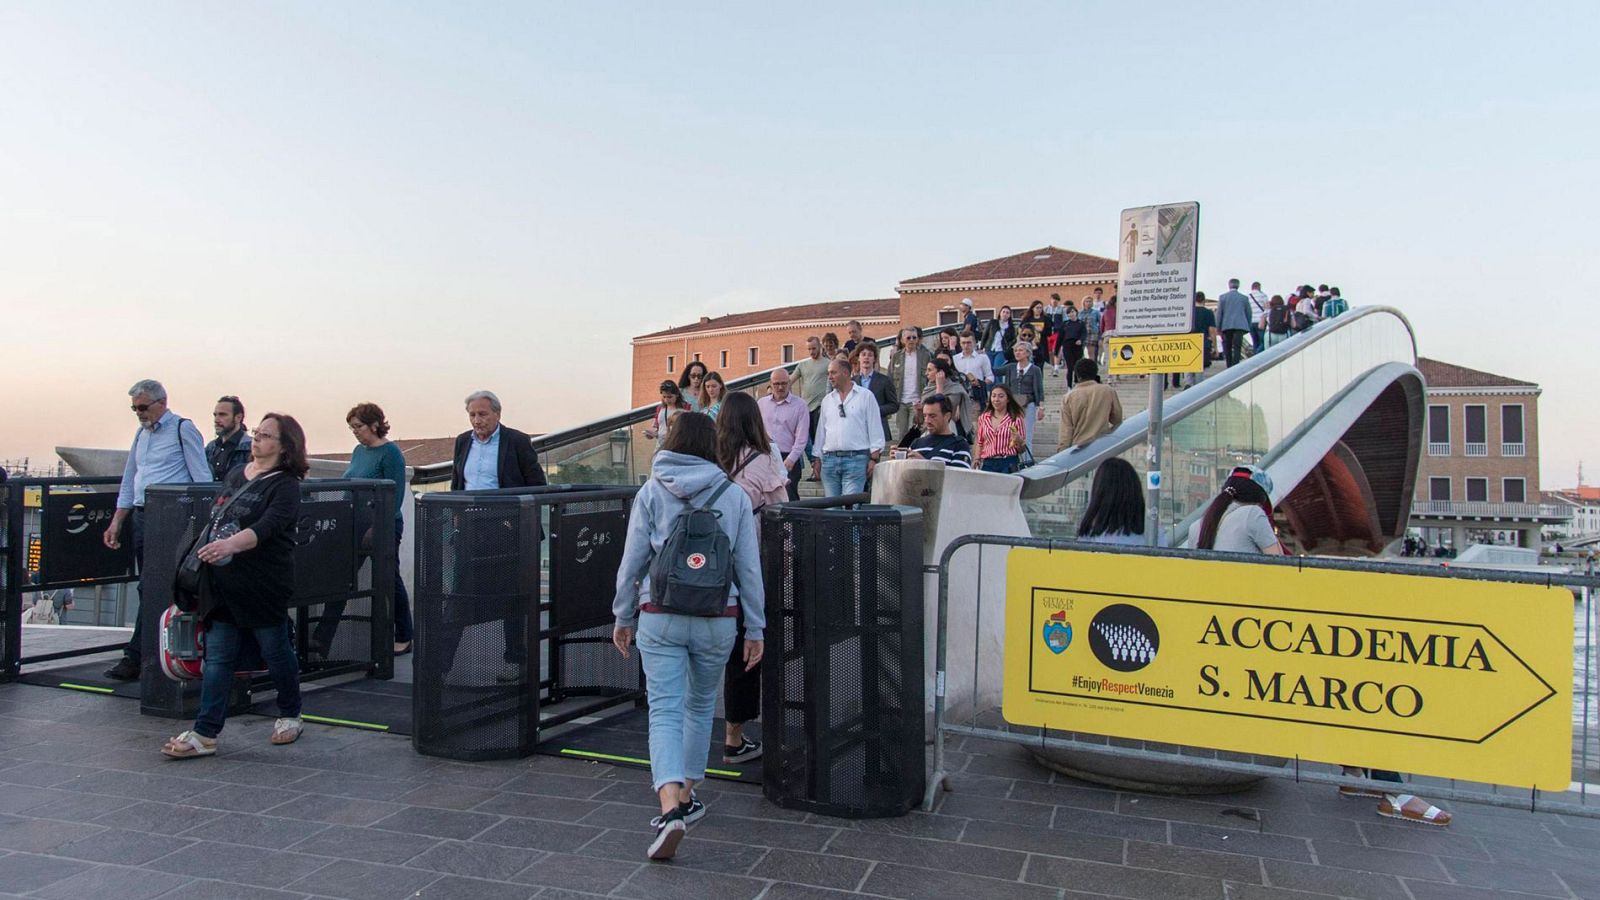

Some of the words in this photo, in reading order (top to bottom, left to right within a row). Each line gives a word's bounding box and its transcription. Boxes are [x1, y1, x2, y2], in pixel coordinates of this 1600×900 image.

[1140, 342, 1192, 352] ACCADEMIA
[1149, 355, 1180, 364] MARCO
[88, 509, 111, 523] eps
[1197, 615, 1498, 673] ACCADEMIA
[1072, 675, 1174, 698] #EnjoyRespectVenezia
[1198, 664, 1230, 698] S.
[1244, 669, 1423, 718] MARCO
